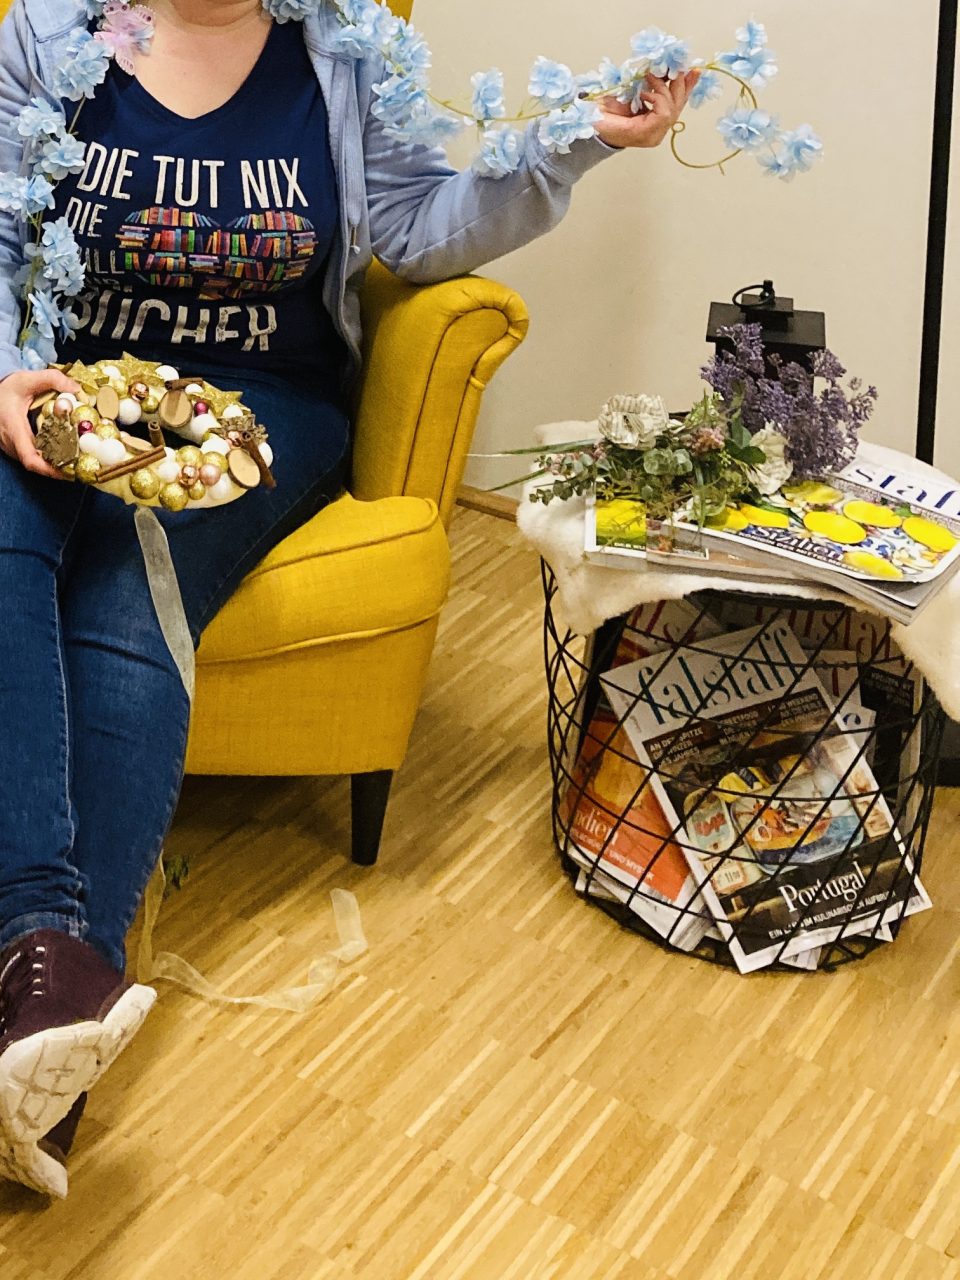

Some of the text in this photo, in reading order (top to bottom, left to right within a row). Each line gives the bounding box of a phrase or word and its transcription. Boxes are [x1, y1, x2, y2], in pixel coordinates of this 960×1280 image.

[76, 141, 309, 209] DIE TUT NIX
[65, 196, 108, 238] DIE
[77, 248, 125, 274] ILL
[757, 526, 844, 561] Sizilien
[638, 626, 804, 726] falstaff
[649, 739, 662, 752] AN
